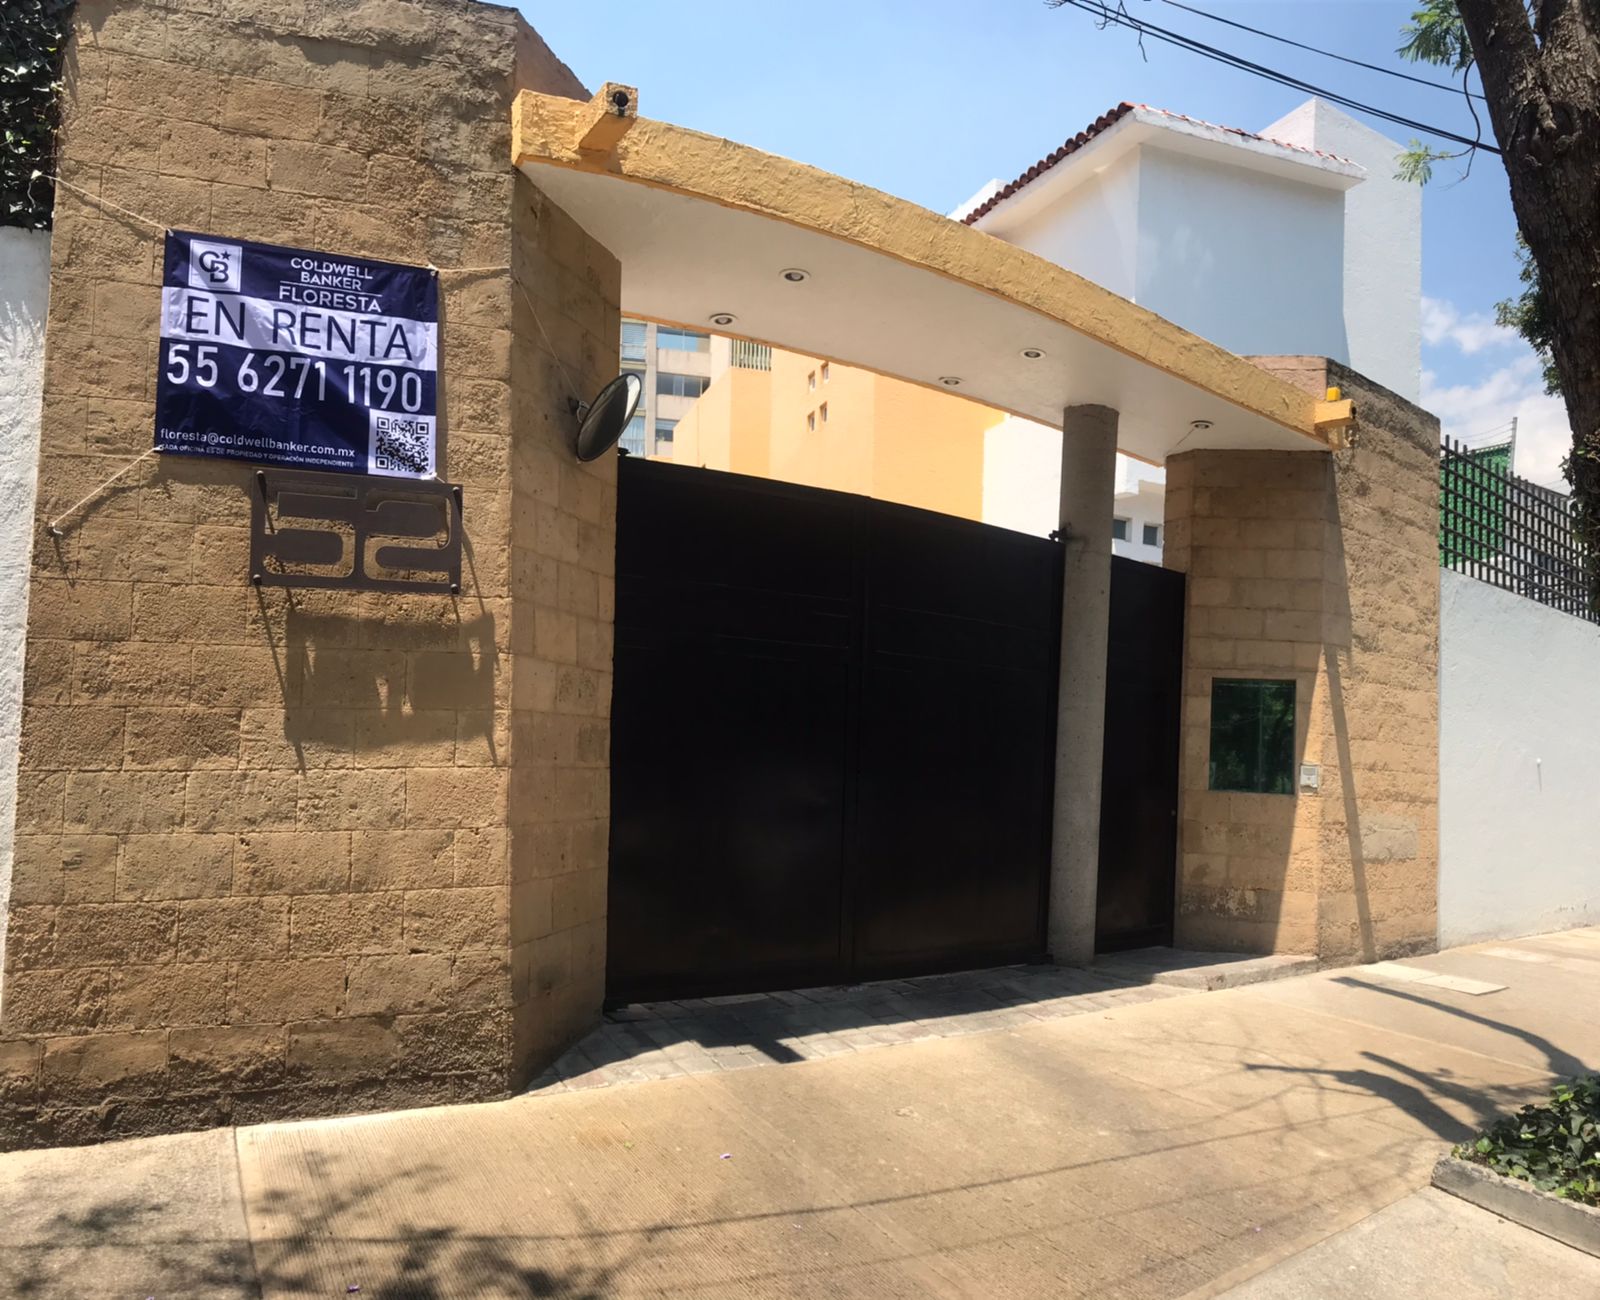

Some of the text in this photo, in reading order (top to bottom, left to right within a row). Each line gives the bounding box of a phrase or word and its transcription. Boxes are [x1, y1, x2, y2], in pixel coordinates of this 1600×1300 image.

[291, 257, 373, 279] COLDWELL
[301, 272, 361, 290] BANKER
[279, 286, 382, 312] FLORESTA
[186, 296, 412, 360] EN RENTA
[167, 344, 422, 412] 55 6271 1190
[160, 428, 355, 457] floresta@coldwellbanker.com.mx
[180, 445, 204, 453] OFICINA
[227, 449, 262, 458] PROPIEDAD
[269, 453, 304, 463] OPERACIÓN
[305, 457, 354, 467] INDEPENDIENTE
[262, 482, 452, 584] 52
